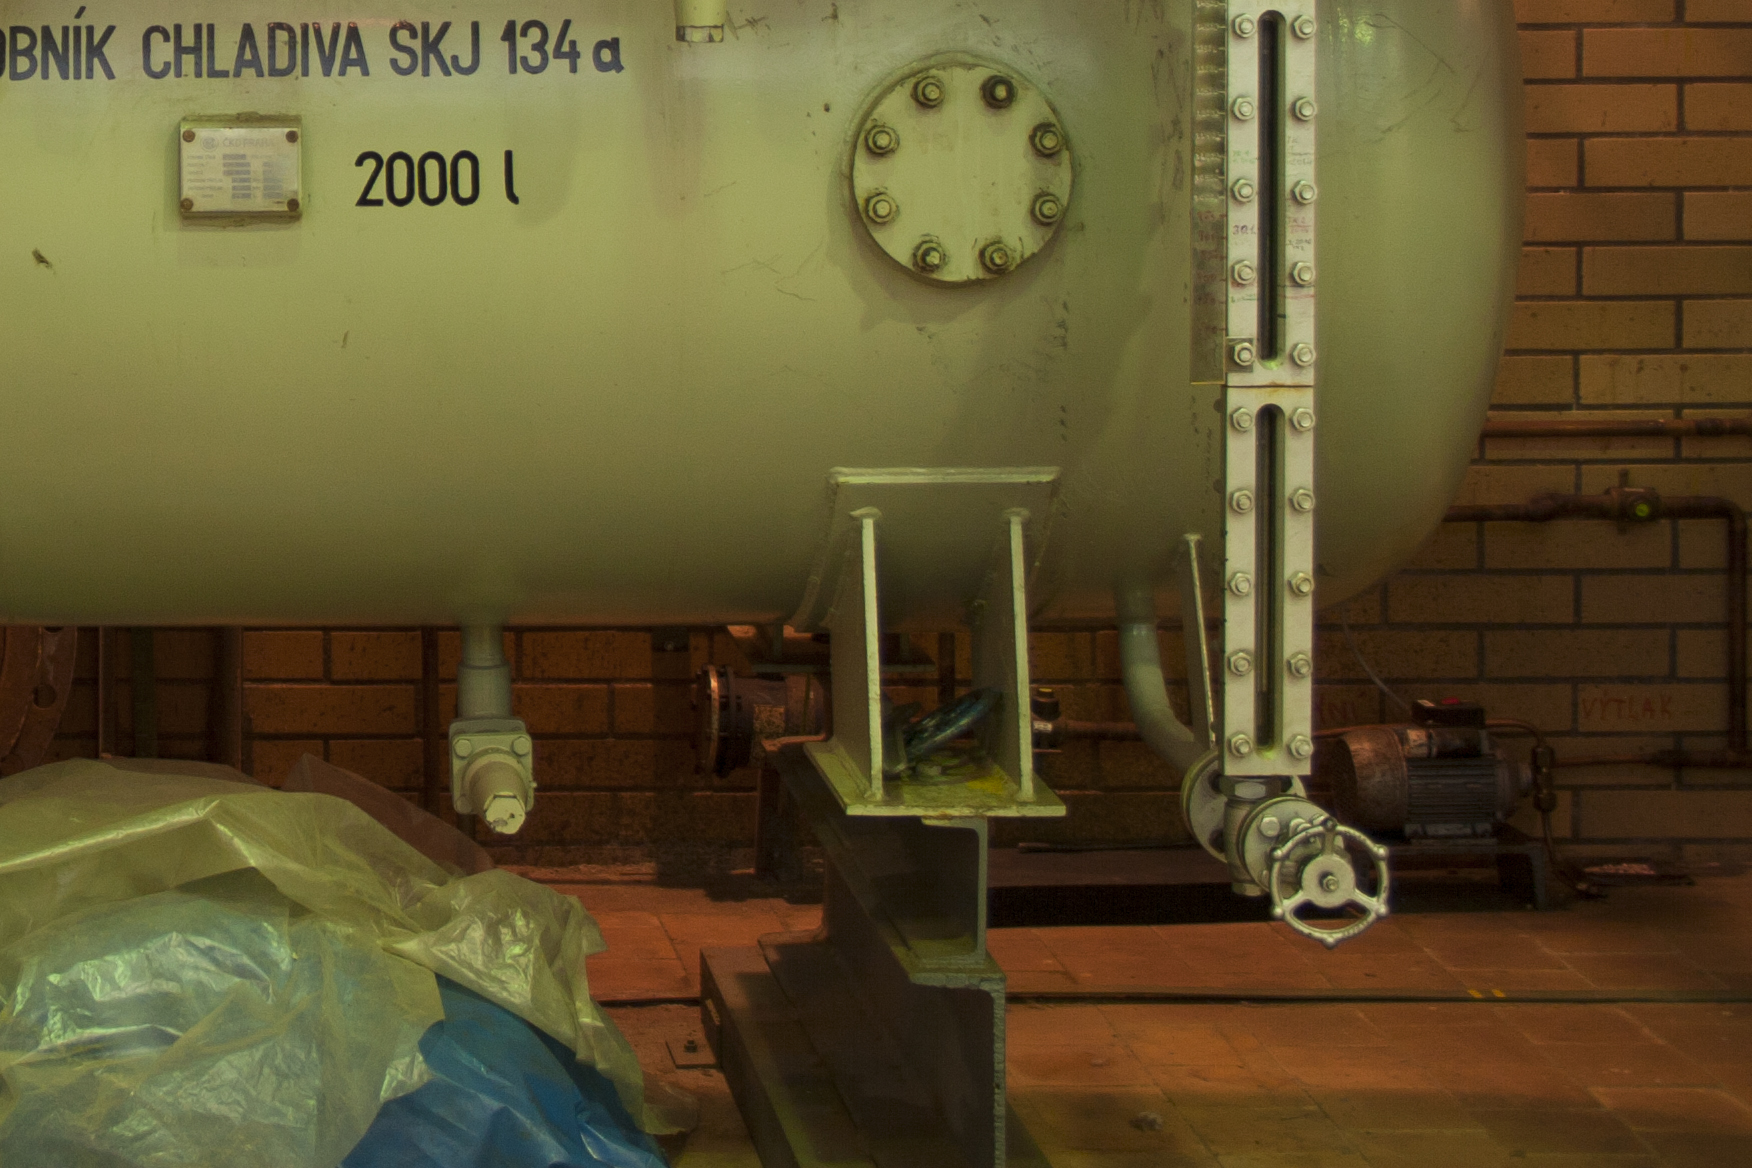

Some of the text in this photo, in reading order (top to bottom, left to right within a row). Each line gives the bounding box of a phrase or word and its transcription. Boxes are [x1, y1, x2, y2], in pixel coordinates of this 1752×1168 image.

[141, 21, 369, 79] CHLADIVA
[389, 20, 481, 78] SKJ
[355, 149, 480, 207] 2000
[1581, 690, 1673, 722] VÝTLAK
